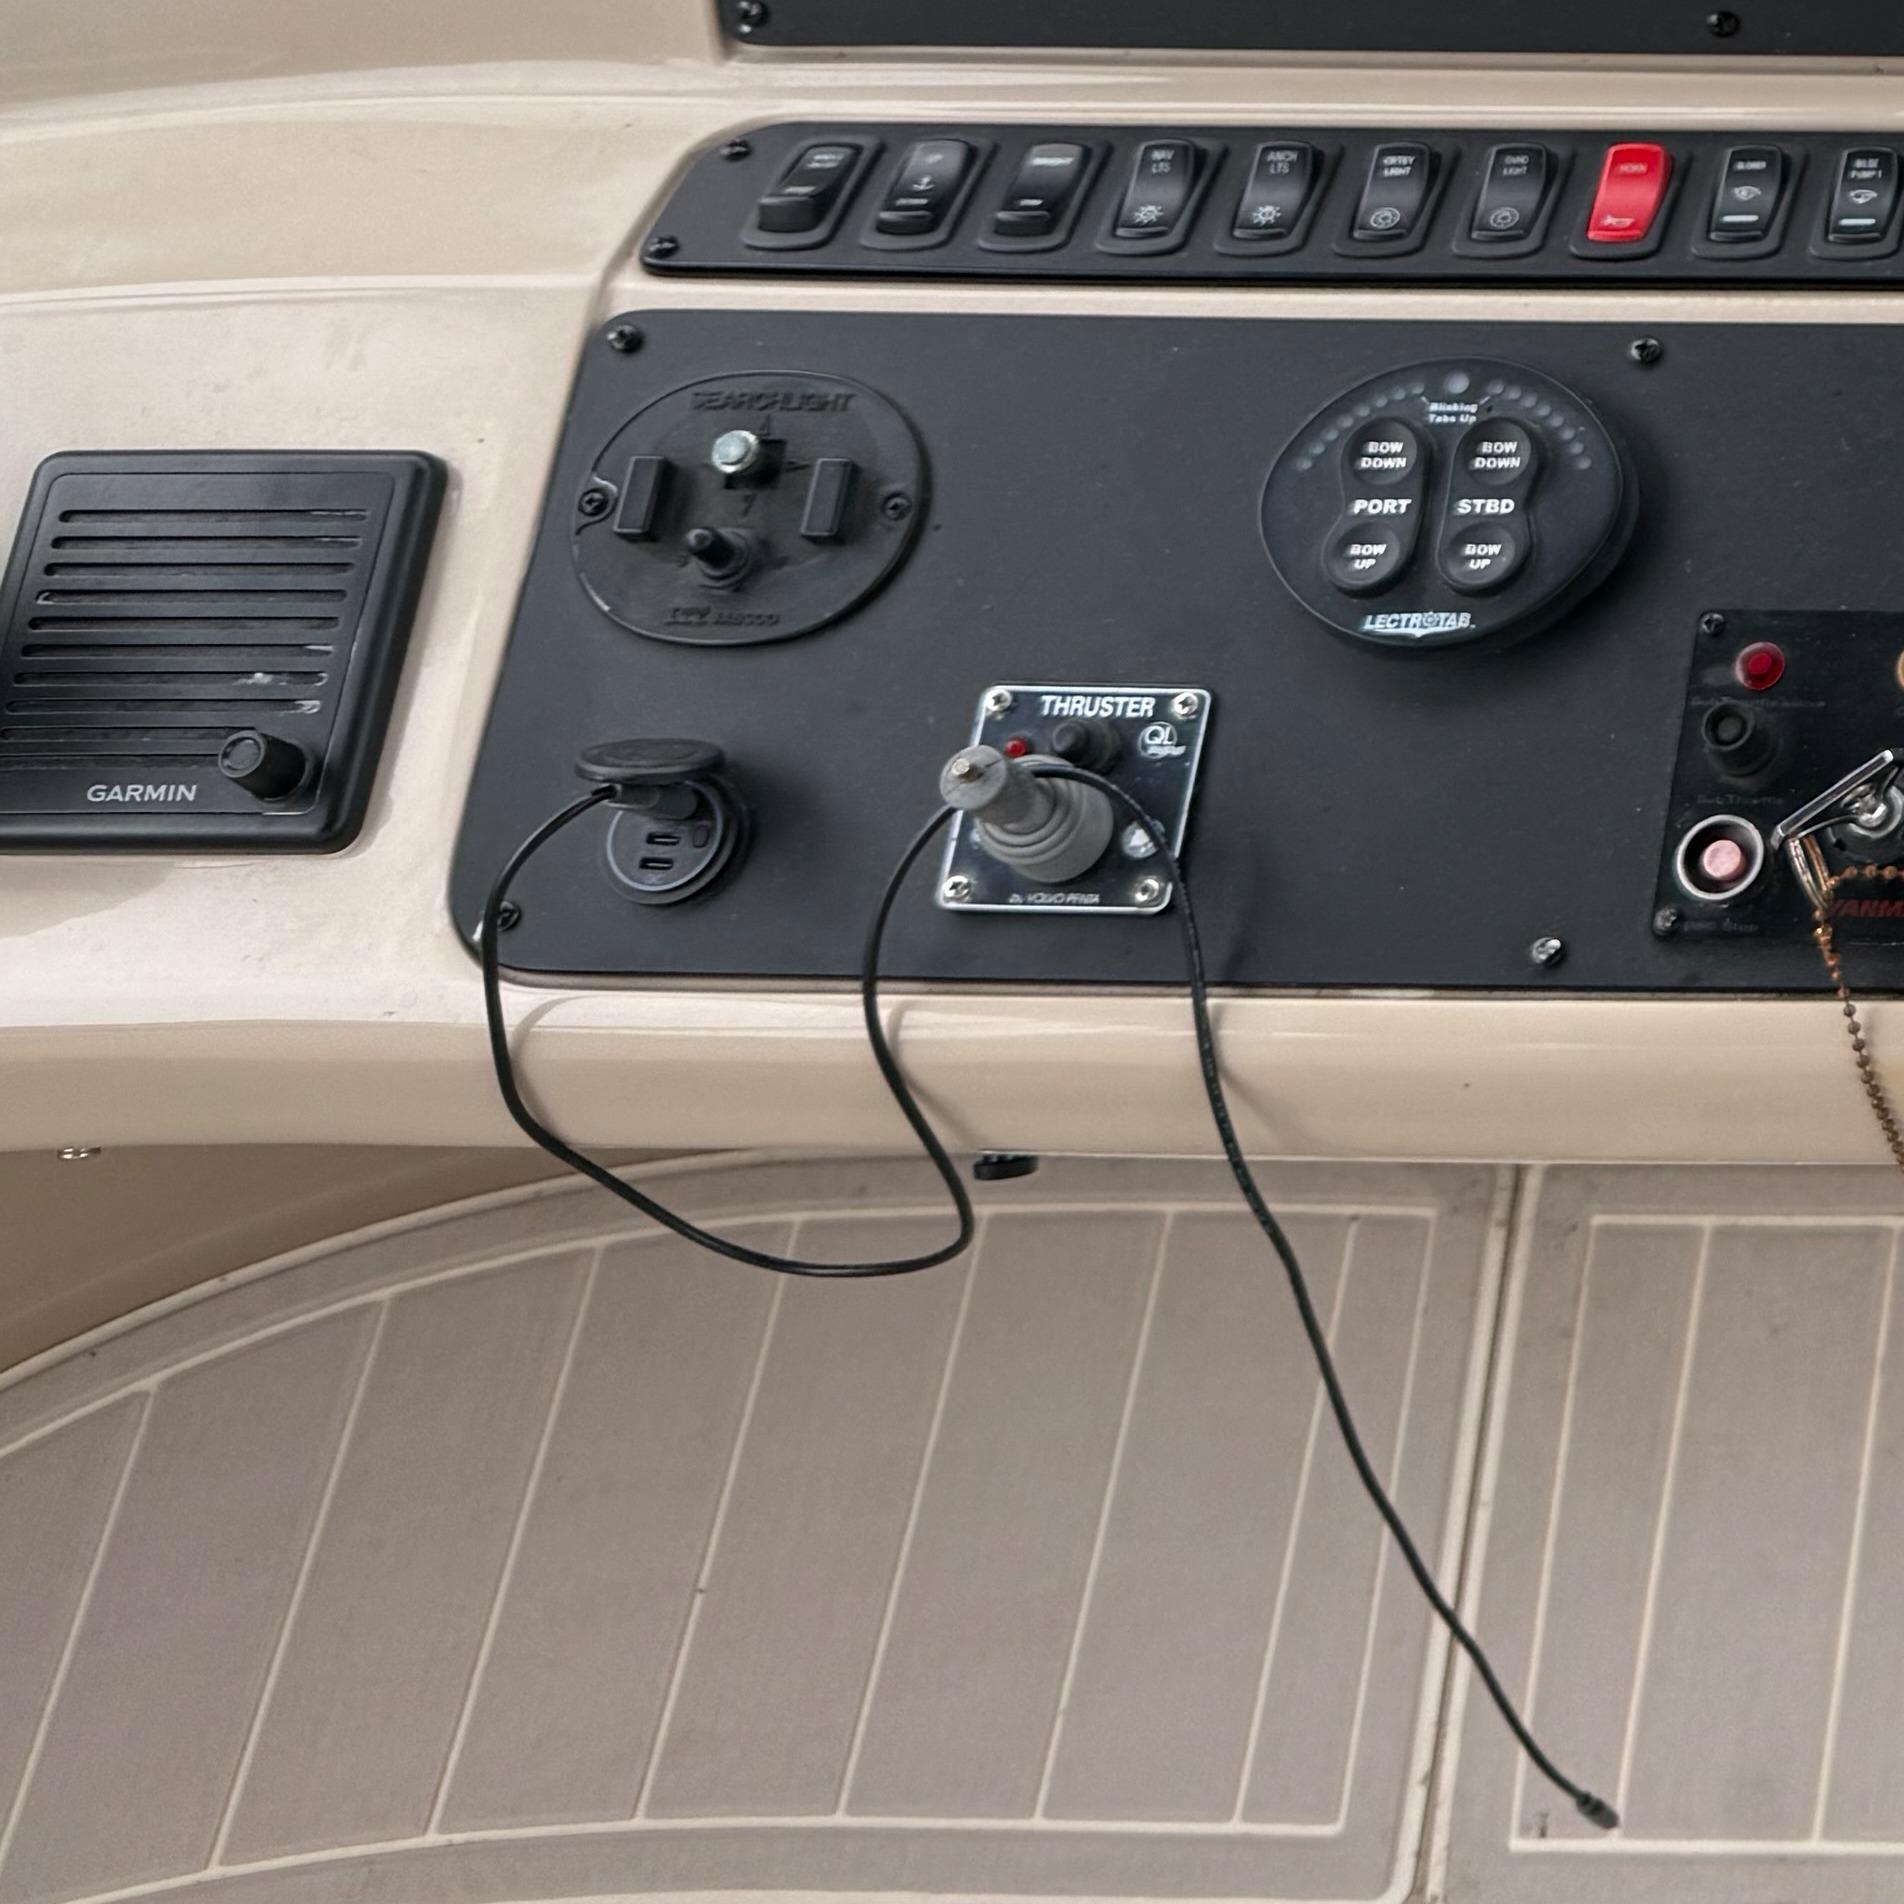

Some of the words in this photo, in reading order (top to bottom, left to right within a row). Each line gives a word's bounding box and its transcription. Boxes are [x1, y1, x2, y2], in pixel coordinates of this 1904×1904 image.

[1430, 401, 1478, 414] Blinking
[1429, 413, 1459, 424] Tabs
[1462, 413, 1477, 425] Up
[1366, 441, 1403, 454] BOW
[1481, 441, 1518, 454] BOW
[1360, 457, 1407, 469] DOWN
[1474, 457, 1521, 469] DOWN
[1353, 498, 1412, 515] PORT
[1457, 498, 1515, 515] STBD
[1350, 543, 1386, 556] BOW
[1464, 543, 1502, 556] BOW
[1354, 558, 1376, 570] UP
[1468, 558, 1491, 570] UP
[1364, 611, 1476, 631] LECTROTAB
[1040, 695, 1156, 718] THRUSTER
[1145, 725, 1175, 746] QL
[87, 784, 197, 802] GARMIN
